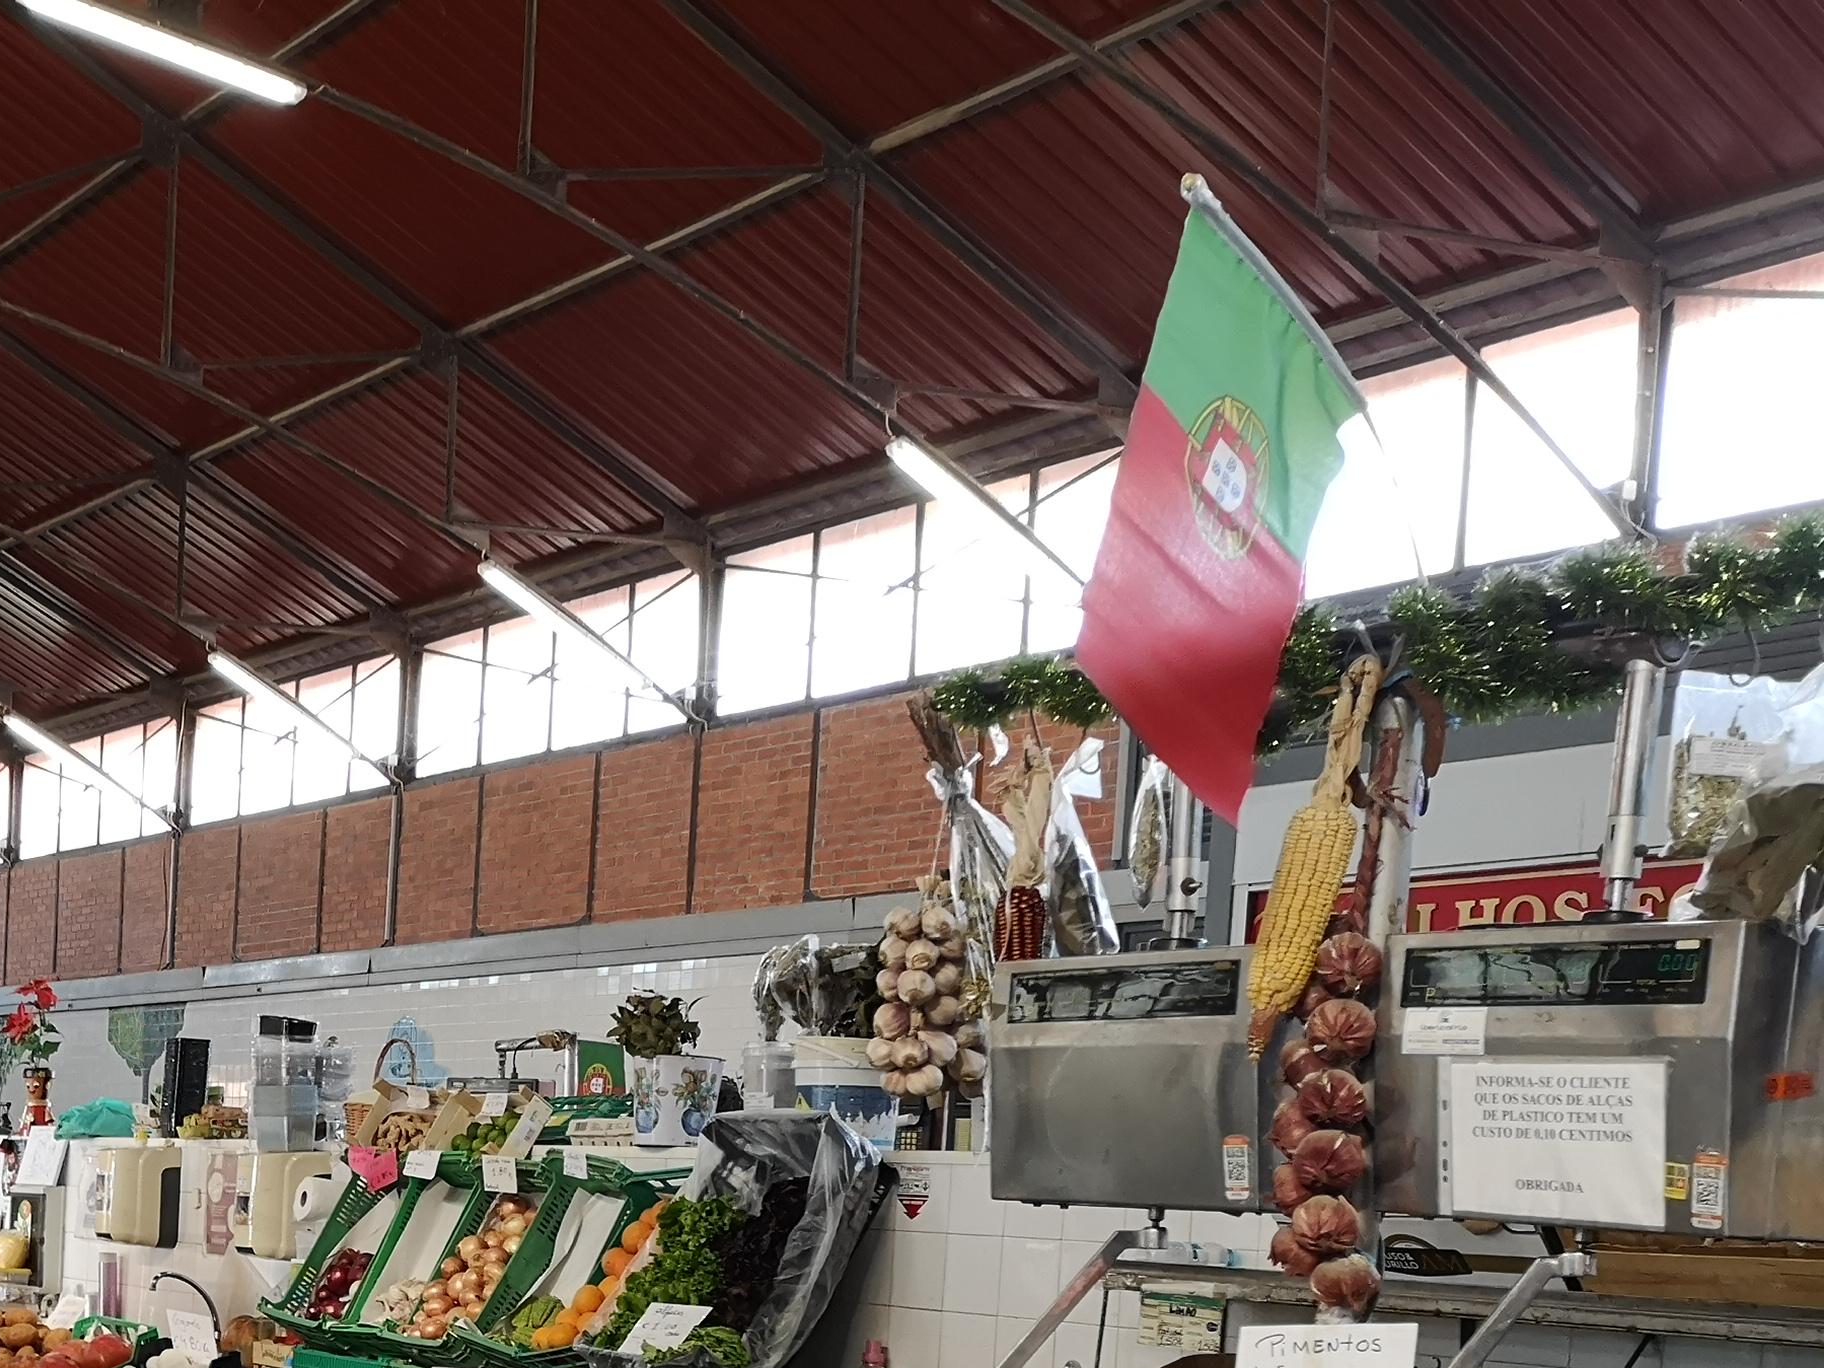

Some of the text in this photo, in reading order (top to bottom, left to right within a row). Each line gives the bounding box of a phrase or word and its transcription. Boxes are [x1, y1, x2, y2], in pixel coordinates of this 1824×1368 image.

[1476, 1075, 1630, 1090] INFORMA-SE O CLIENTE
[1475, 1092, 1633, 1108] QUE OS SACOS DE ALÇAS
[1483, 1110, 1624, 1125] DE PLASTICO TEM UM
[1472, 1126, 1513, 1139] CUSTO
[1516, 1128, 1532, 1139] DE
[1559, 1129, 1633, 1143] CENTIMOS
[1515, 1179, 1584, 1193] OBRIGADA
